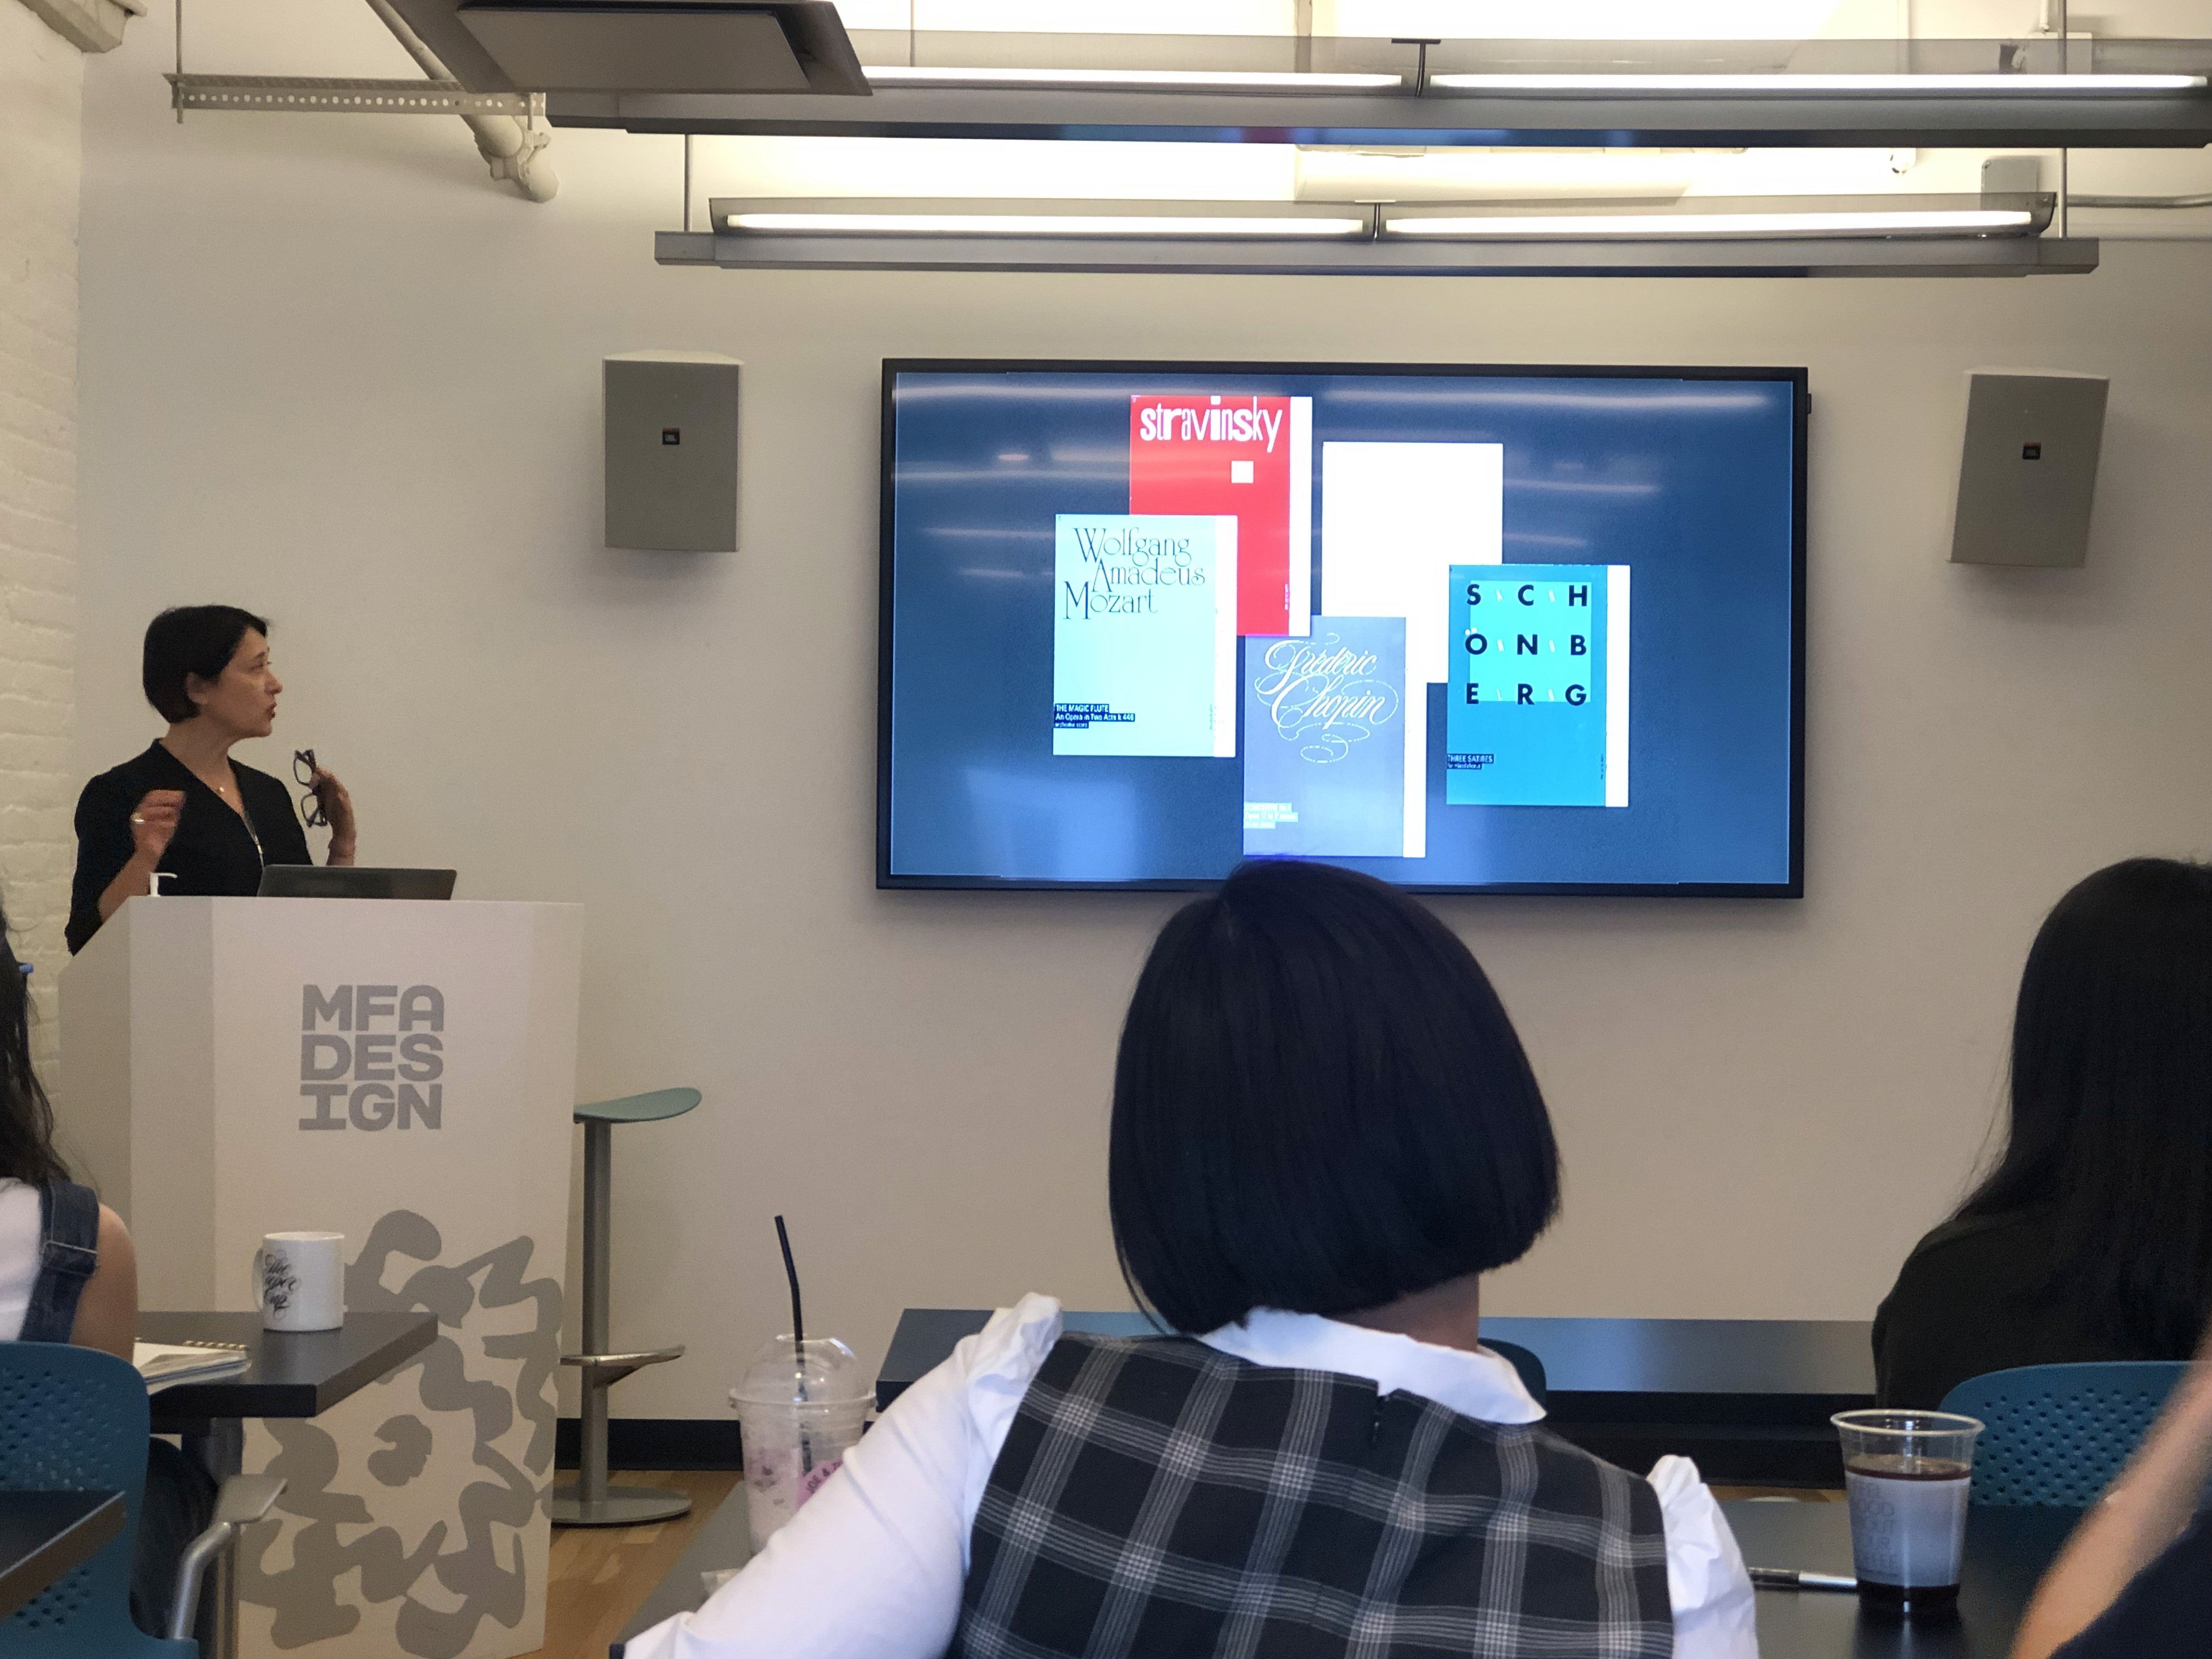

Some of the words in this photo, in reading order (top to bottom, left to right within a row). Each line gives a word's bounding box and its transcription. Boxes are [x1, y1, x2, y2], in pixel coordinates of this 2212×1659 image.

[1140, 396, 1283, 453] stravinsky
[1071, 527, 1192, 567] Wolfgang
[1091, 557, 1205, 592] Amadeus
[1063, 580, 1159, 619] Mozart
[1065, 713, 1083, 721] Opera
[1090, 704, 1109, 713] FLUTE
[1265, 673, 1395, 731] Chopin
[1447, 754, 1466, 763] THREE
[1467, 754, 1493, 763] SATIRES
[302, 984, 444, 1031] MFA
[301, 1033, 444, 1082] DES
[299, 1083, 442, 1131] IGN
